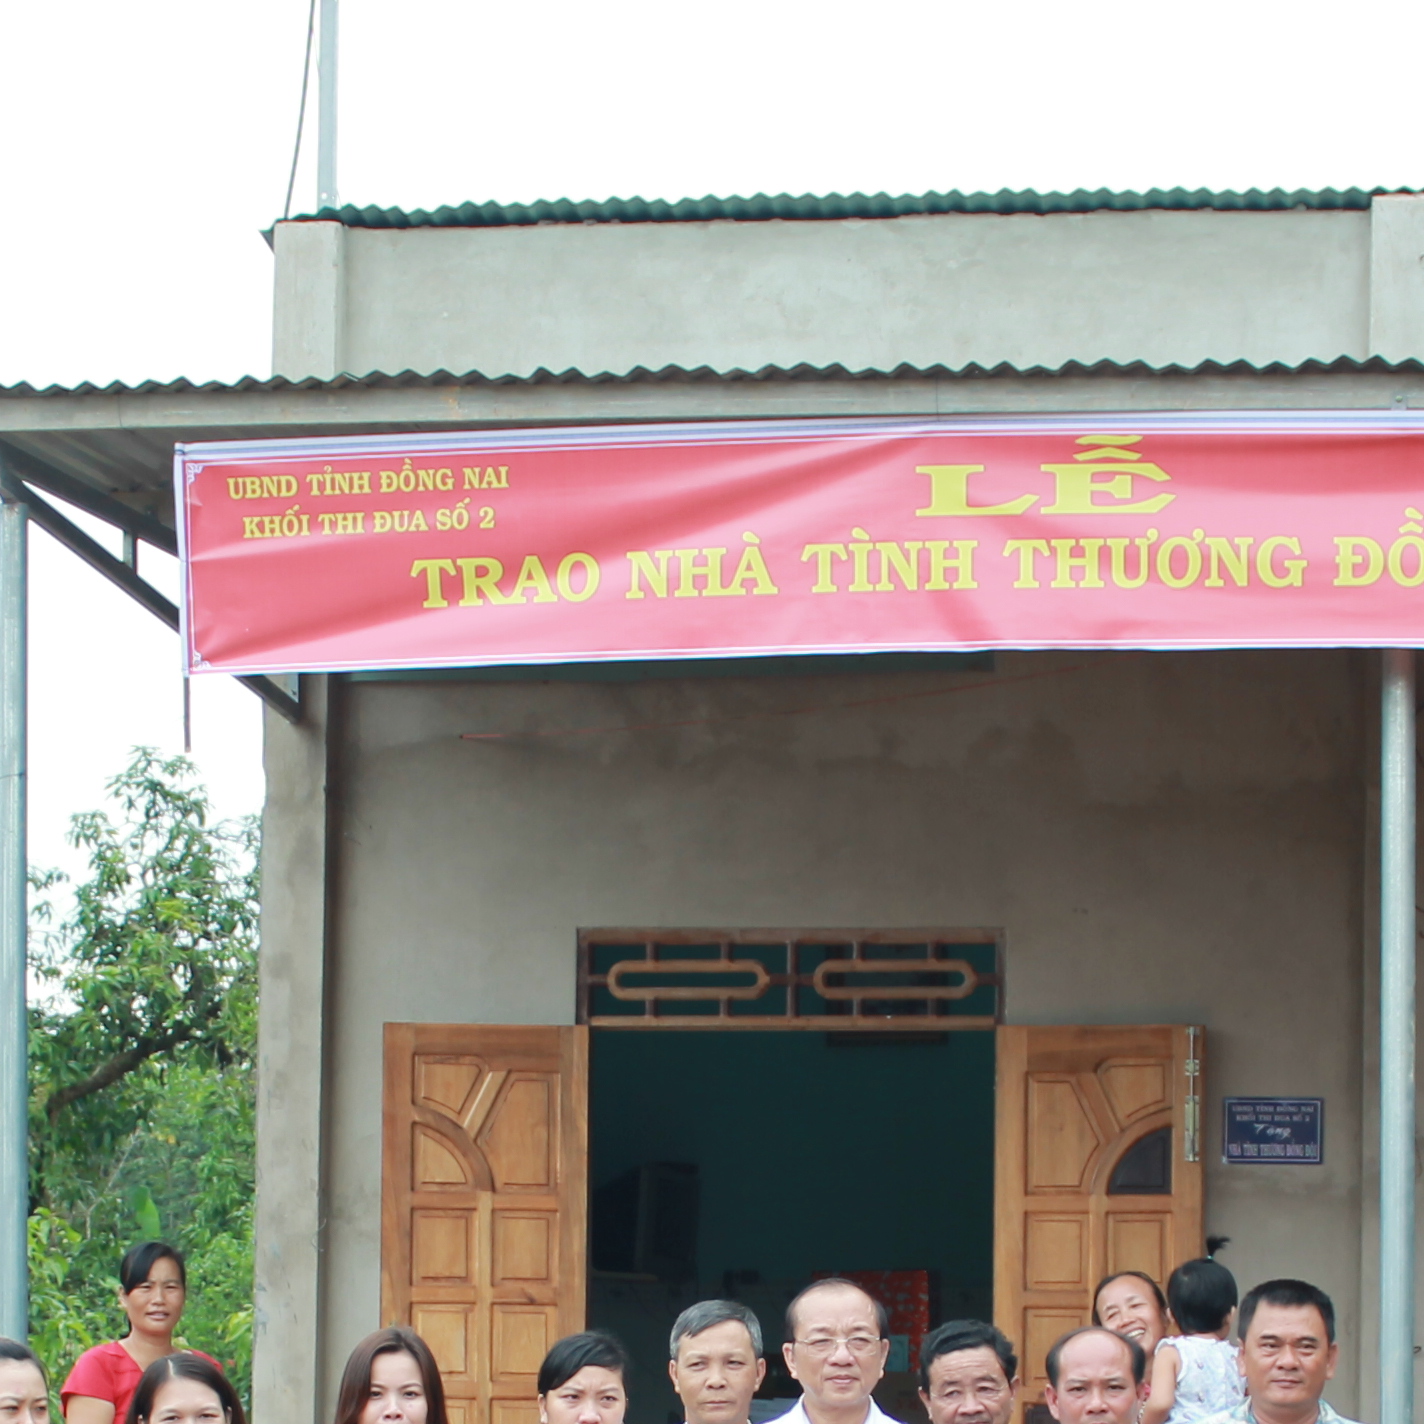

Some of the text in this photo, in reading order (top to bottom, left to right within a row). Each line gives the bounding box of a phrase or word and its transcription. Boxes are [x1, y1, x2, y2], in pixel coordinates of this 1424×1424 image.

[226, 458, 510, 500] UBND TỈNH ĐỒNG NAI
[914, 434, 1177, 518] LỄ
[242, 498, 496, 539] KHỐI THI ĐUA SỐ 2
[409, 551, 601, 609] TRAO
[625, 531, 779, 600] NHÀ
[800, 527, 979, 594] TÌNH
[1002, 527, 1309, 590] THƯƠNG
